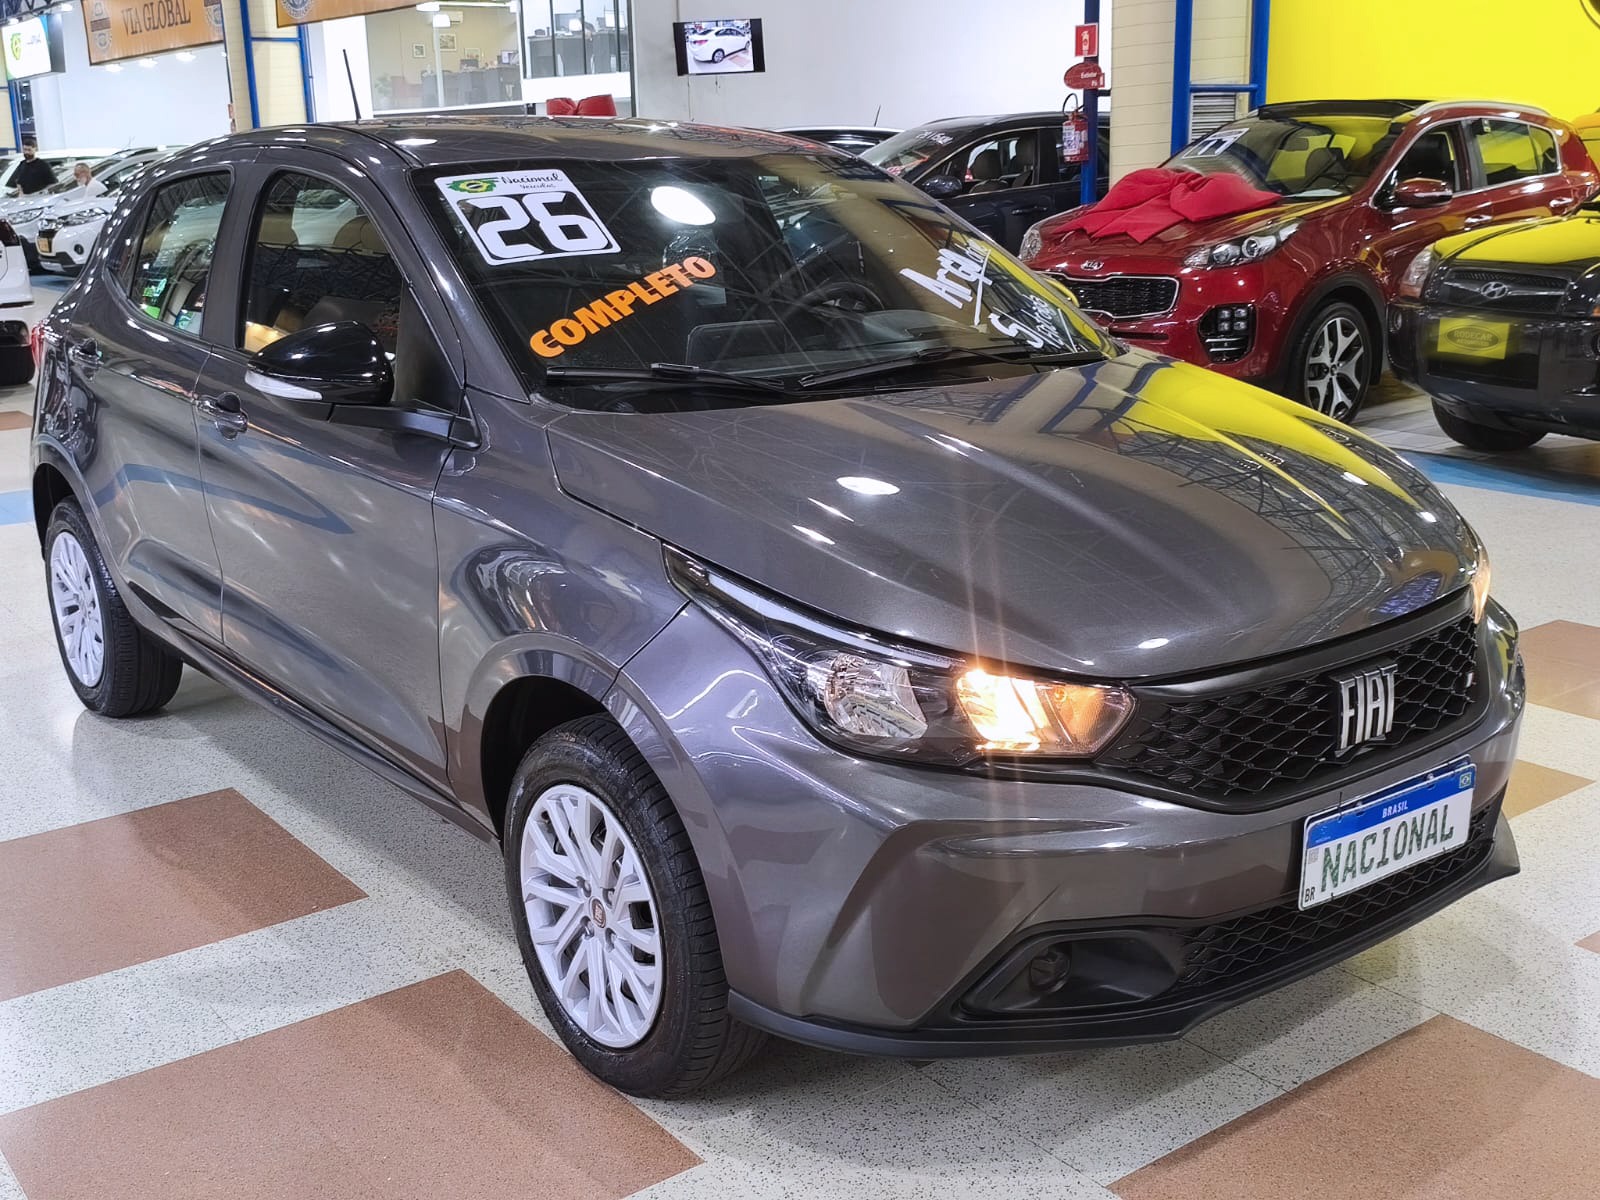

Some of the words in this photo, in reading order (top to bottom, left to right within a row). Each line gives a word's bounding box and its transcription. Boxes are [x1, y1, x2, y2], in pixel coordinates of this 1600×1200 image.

[121, 7, 143, 35] VIA
[143, 0, 191, 32] GLOBAL
[500, 172, 563, 184] Nacional
[476, 191, 608, 259] 26
[529, 256, 717, 358] COMPLETO
[1454, 330, 1493, 342] RODECAR
[1340, 664, 1397, 750] FIAT
[1382, 799, 1409, 818] BRASIL
[1320, 804, 1454, 892] NACIONAL
[1304, 886, 1316, 903] BR
